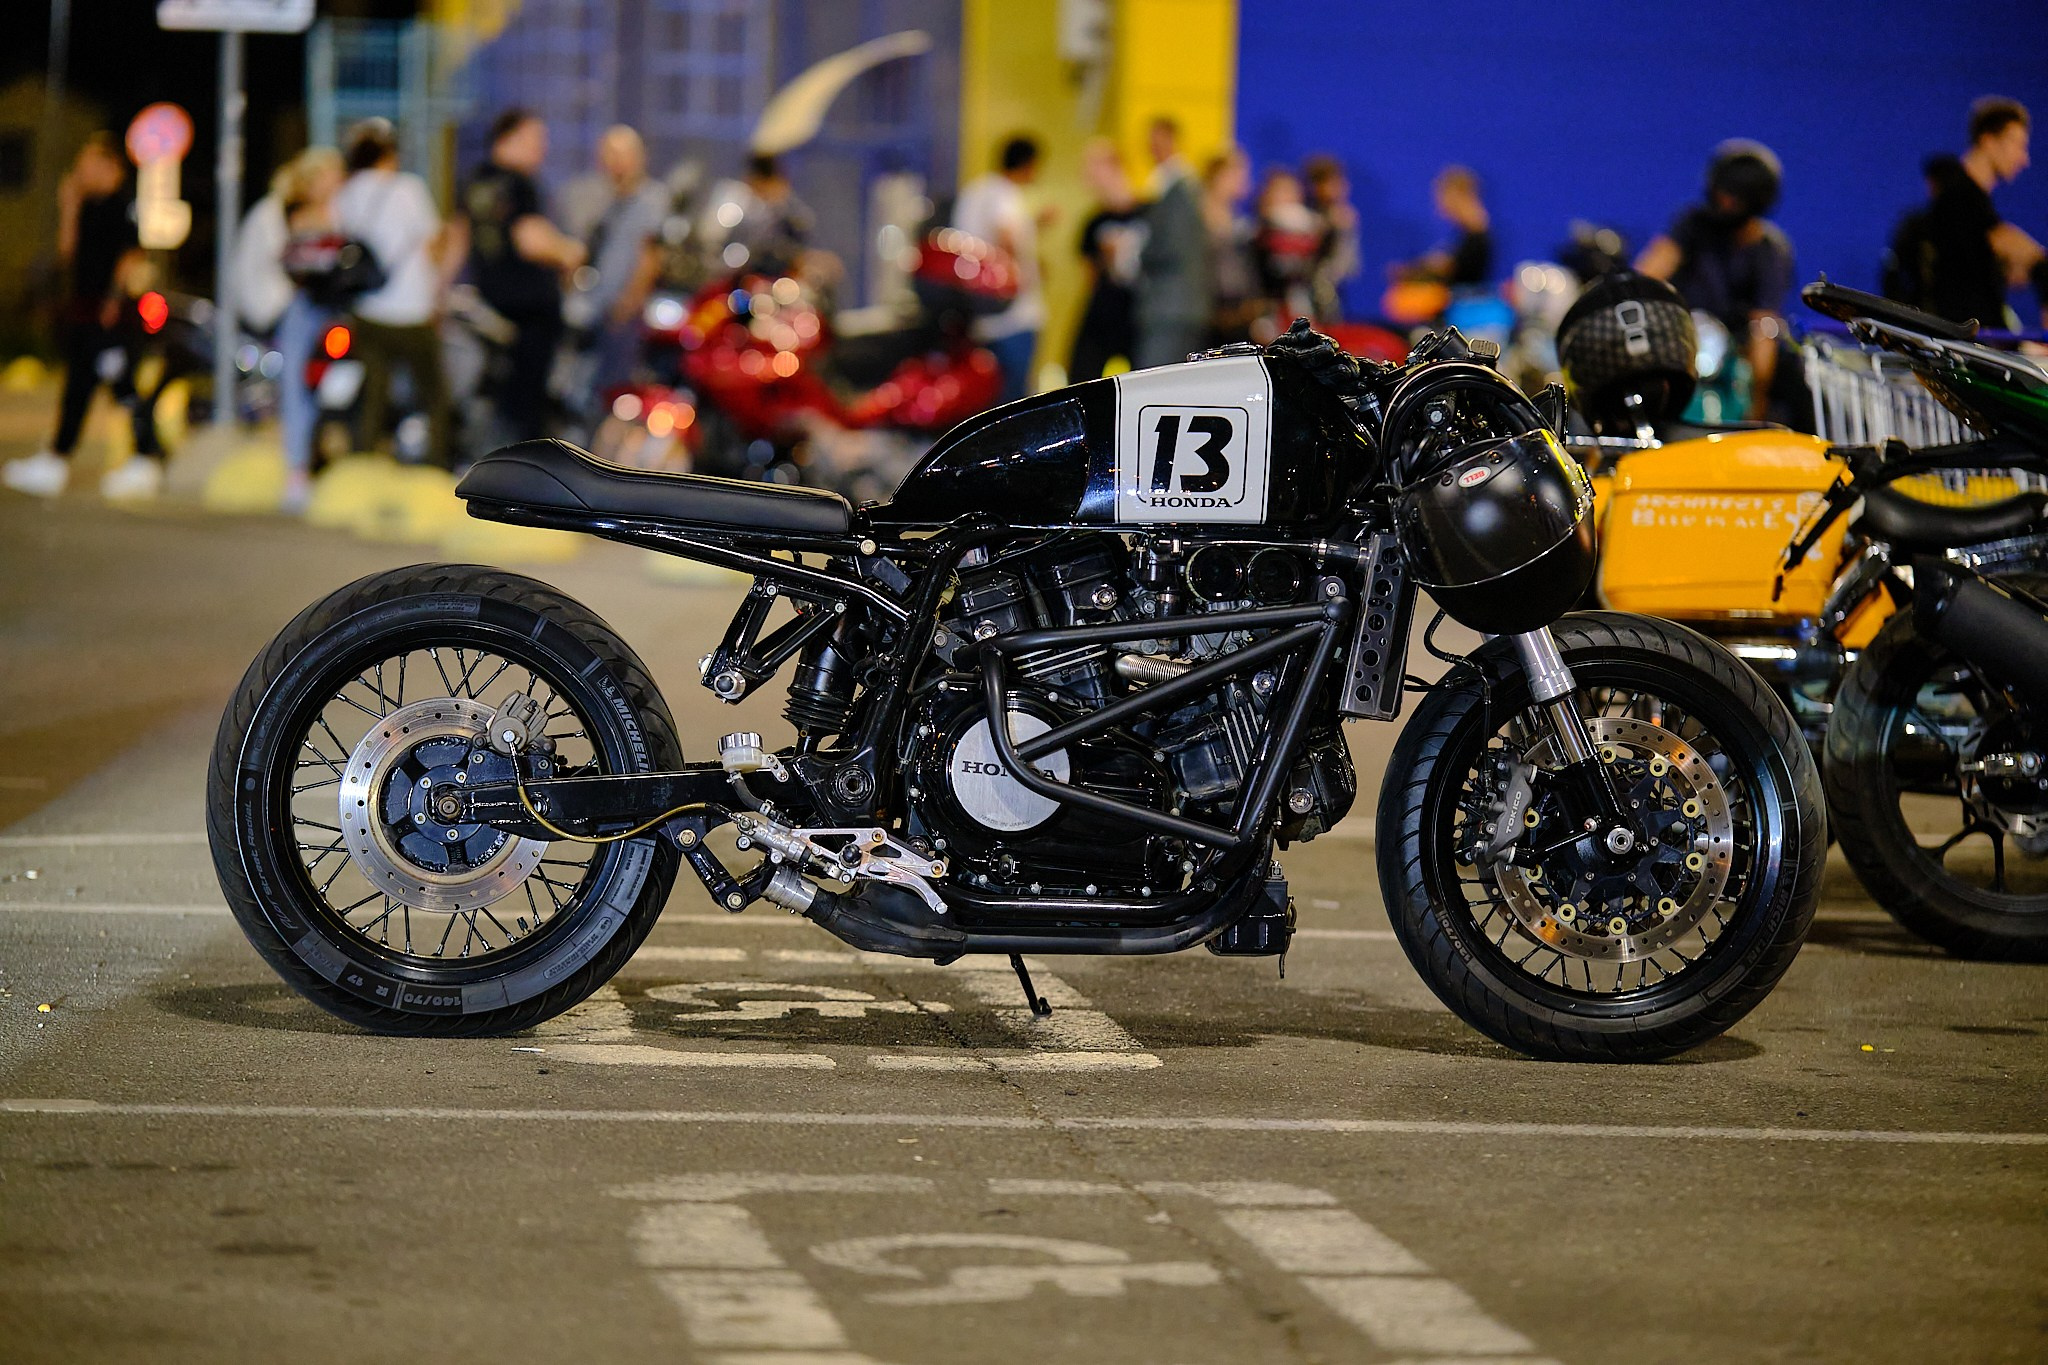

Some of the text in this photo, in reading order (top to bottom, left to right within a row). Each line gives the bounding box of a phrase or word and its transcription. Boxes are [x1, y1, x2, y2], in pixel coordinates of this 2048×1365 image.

[1151, 415, 1234, 493] 13
[1463, 470, 1486, 483] BELL
[1151, 497, 1233, 508] HONDA
[613, 697, 650, 774] MICHELI
[961, 760, 1060, 782] HOA
[244, 799, 257, 847] Radial
[1505, 790, 1522, 834] TOKICO
[251, 848, 273, 897] Street
[1441, 918, 1472, 962] 120/70
[346, 974, 462, 1006] 140/70 R 17
